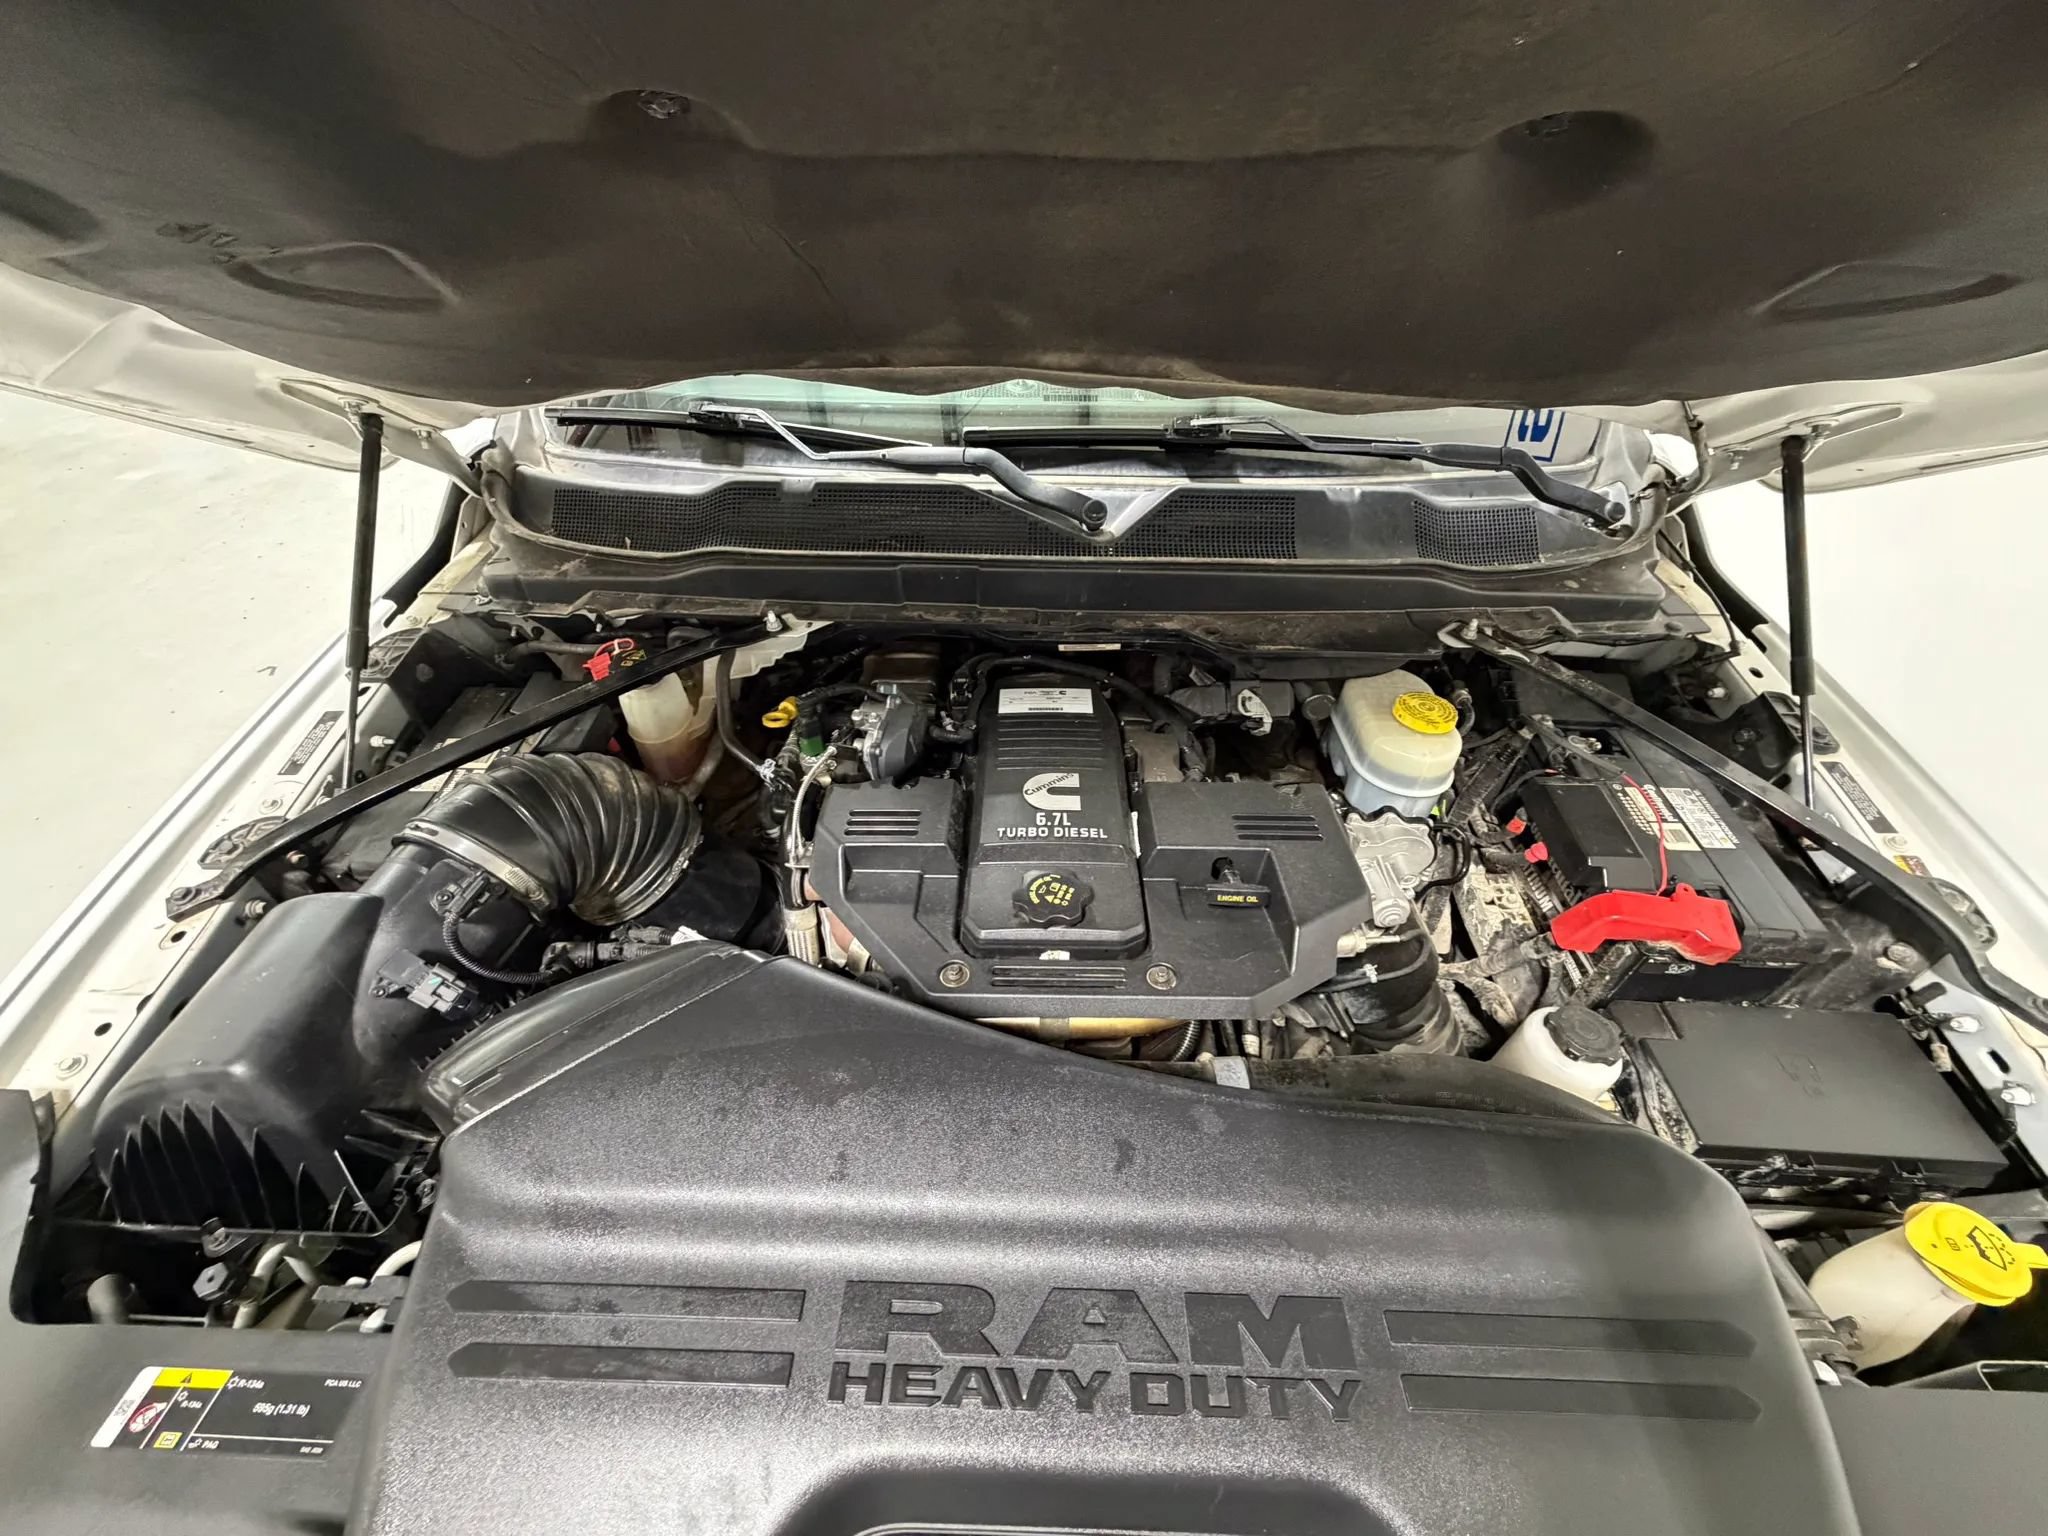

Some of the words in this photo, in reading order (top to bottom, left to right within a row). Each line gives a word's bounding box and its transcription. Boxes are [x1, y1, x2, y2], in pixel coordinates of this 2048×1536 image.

[1024, 772, 1076, 796] Cummins
[1035, 812, 1072, 826] 6.7L
[996, 827, 1049, 838] TURBO
[1053, 827, 1108, 839] DIESEL
[1216, 894, 1245, 903] ENGINE
[1246, 895, 1259, 903] OIL
[833, 1279, 1358, 1372] RAM
[827, 1360, 1112, 1413] HEAVY
[1129, 1370, 1363, 1423] DUTY
